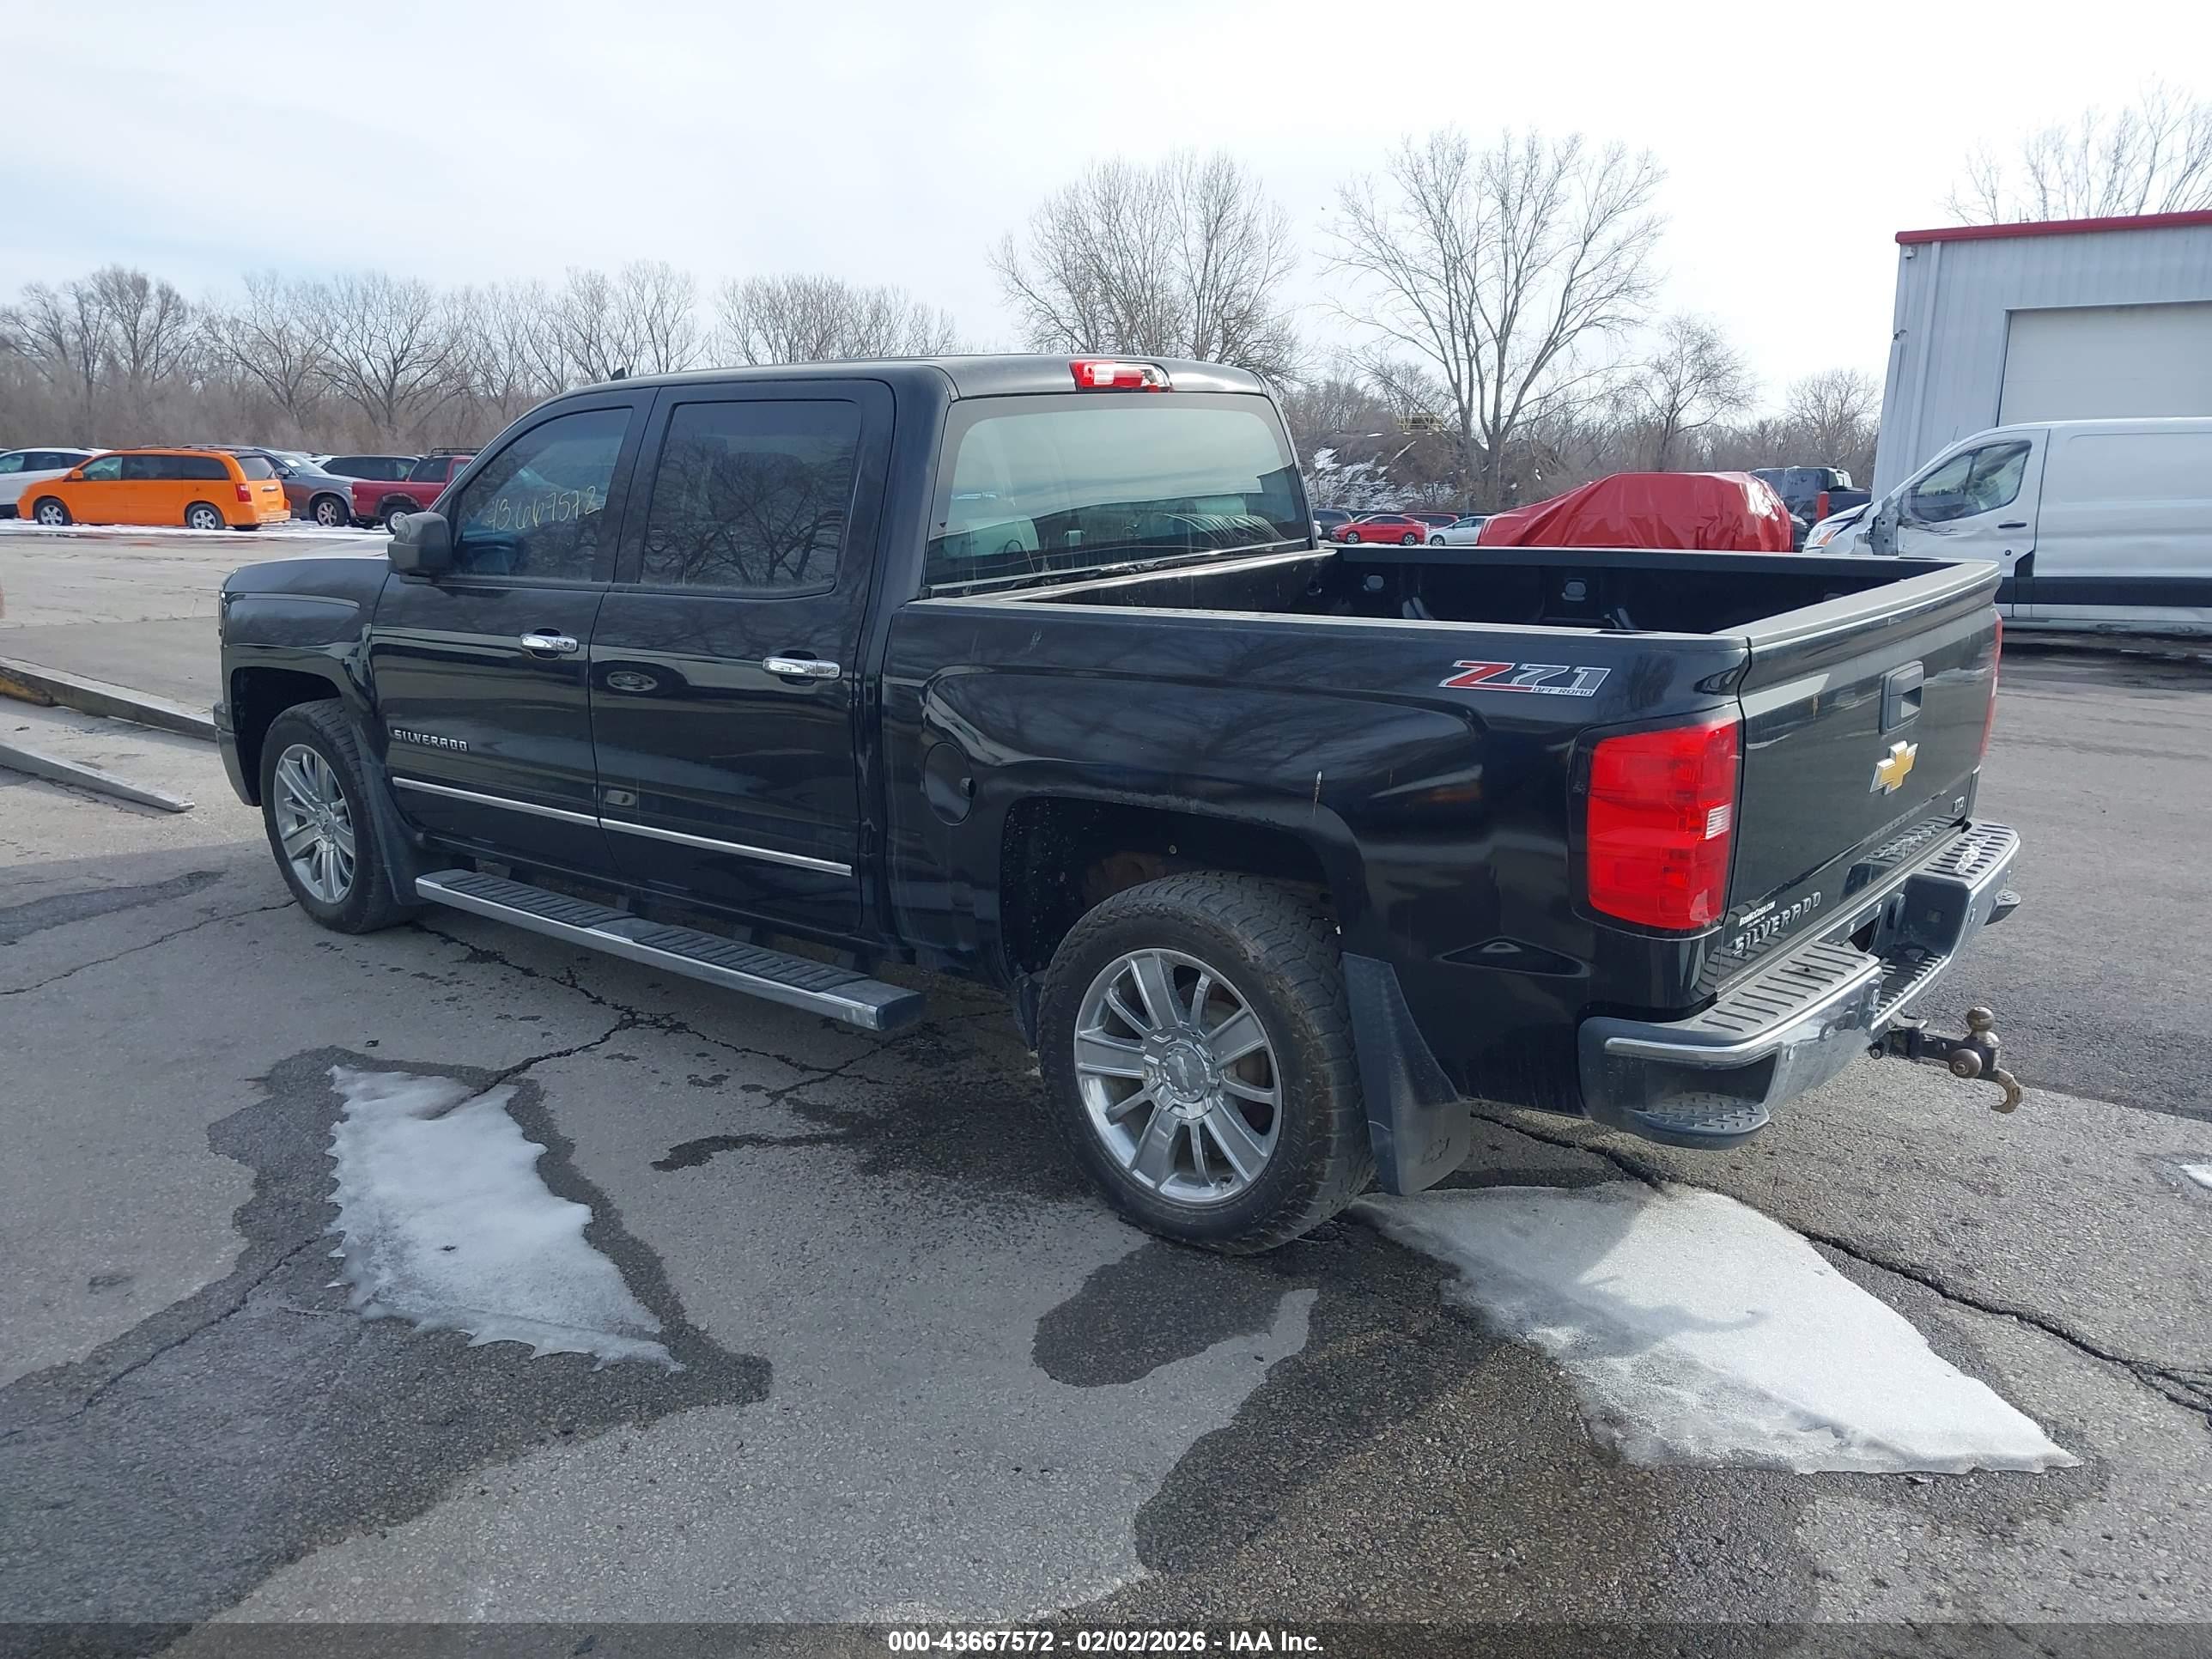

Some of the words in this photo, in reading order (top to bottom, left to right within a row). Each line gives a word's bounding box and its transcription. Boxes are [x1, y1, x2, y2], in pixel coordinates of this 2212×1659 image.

[488, 485, 601, 534] 43667572
[1438, 659, 1612, 693] Z71
[1558, 688, 1594, 696] ROAD
[393, 729, 468, 751] SILVERADO
[1733, 891, 1821, 955] SILVERADO
